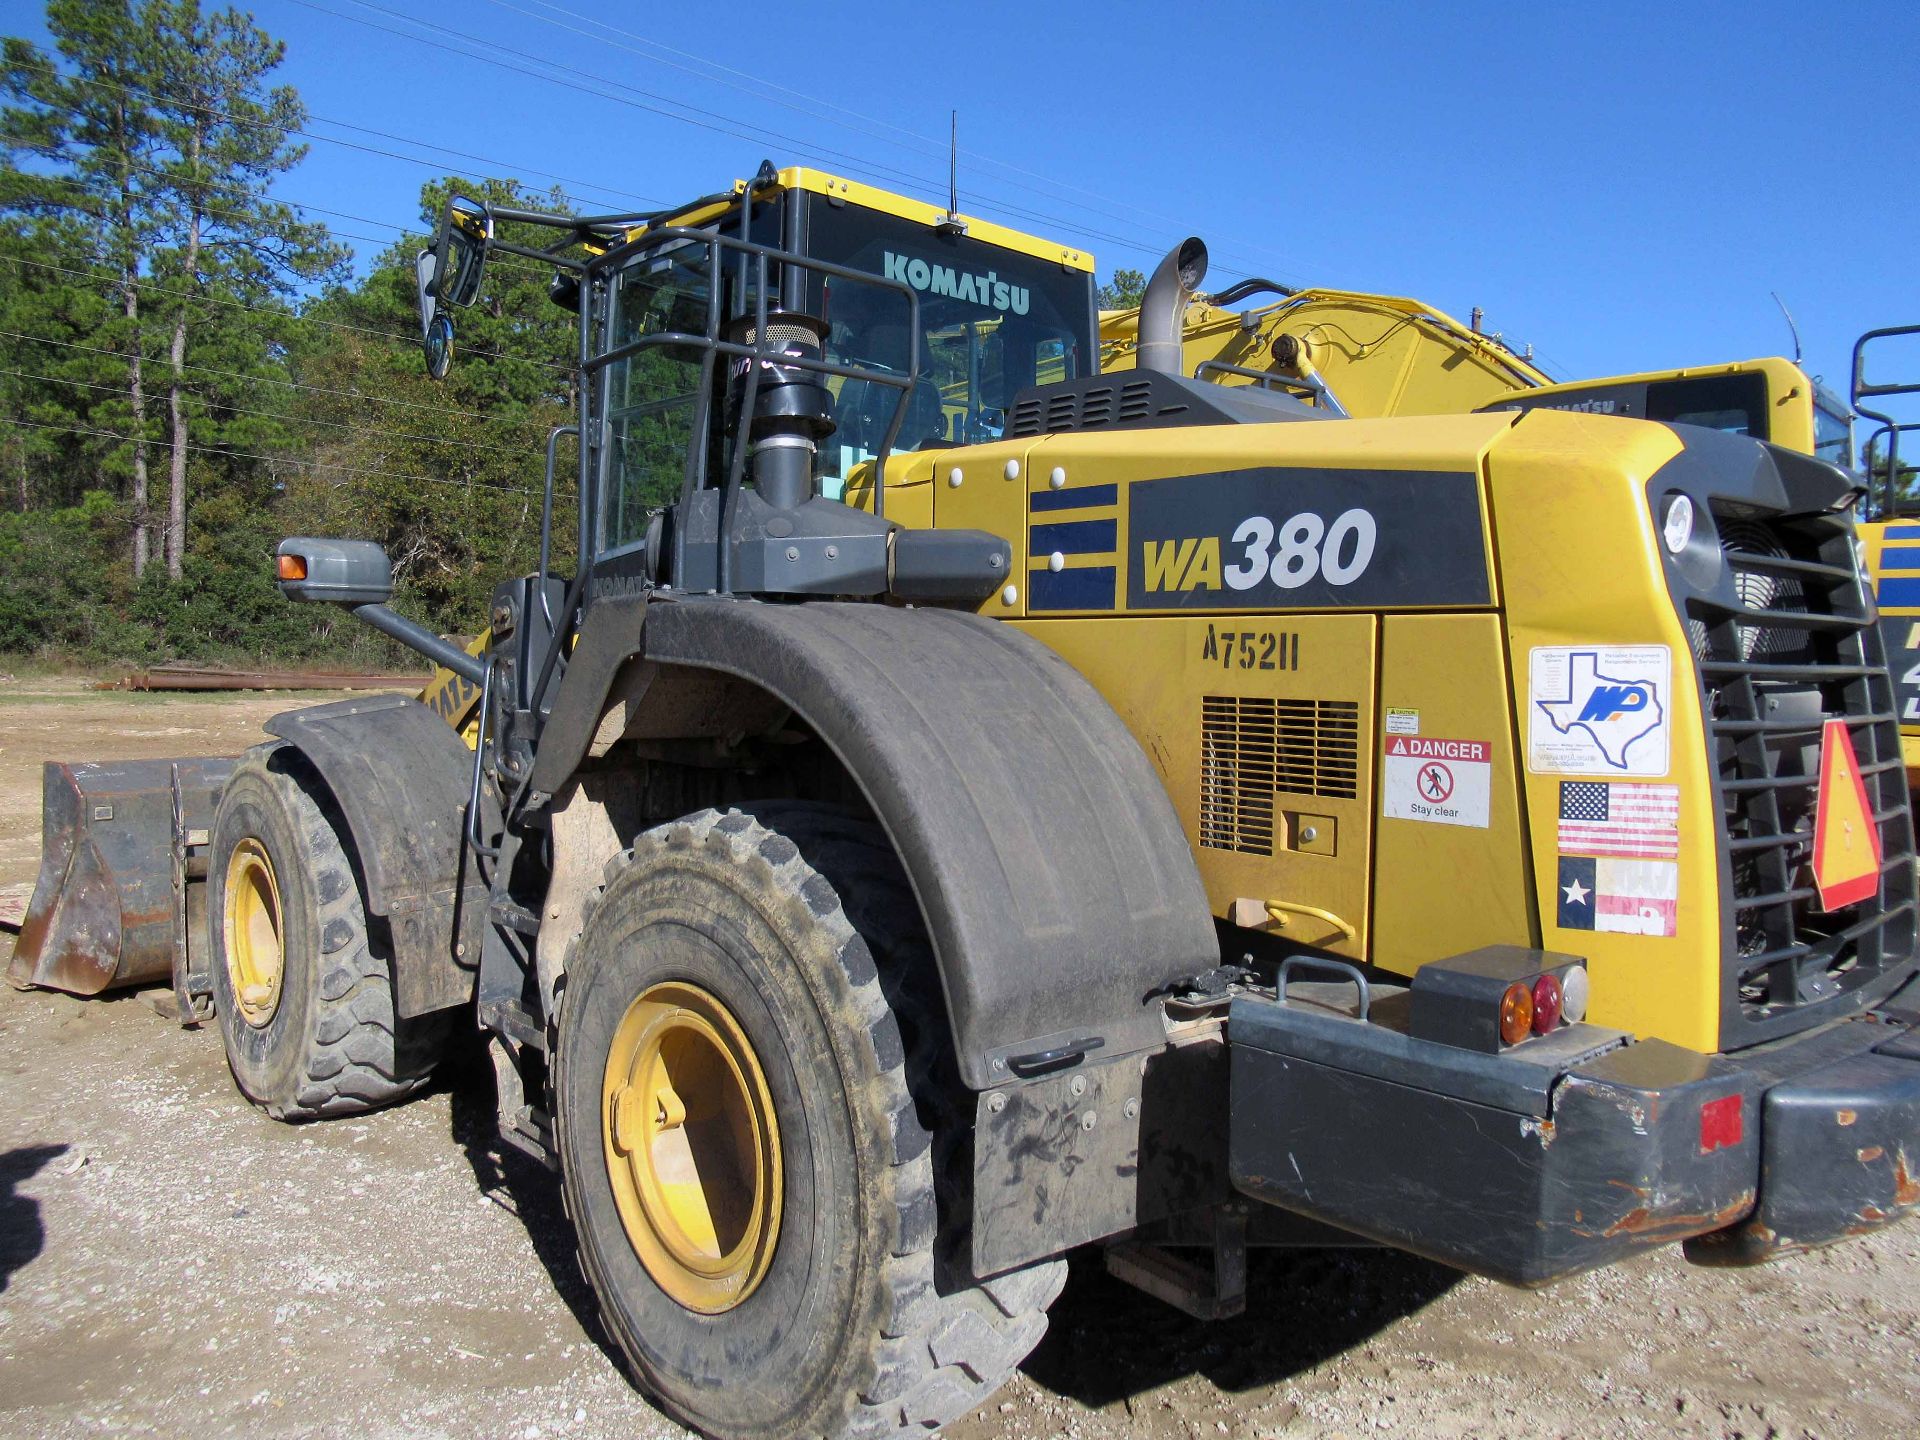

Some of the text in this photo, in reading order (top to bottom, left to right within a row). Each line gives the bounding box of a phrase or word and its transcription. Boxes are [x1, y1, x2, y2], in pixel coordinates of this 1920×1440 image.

[884, 251, 1030, 316] KOMATSU
[1143, 508, 1377, 593] WA380
[1203, 623, 1299, 671] A75211
[1410, 740, 1483, 759] DANGER
[1411, 803, 1459, 817] Stay clear
